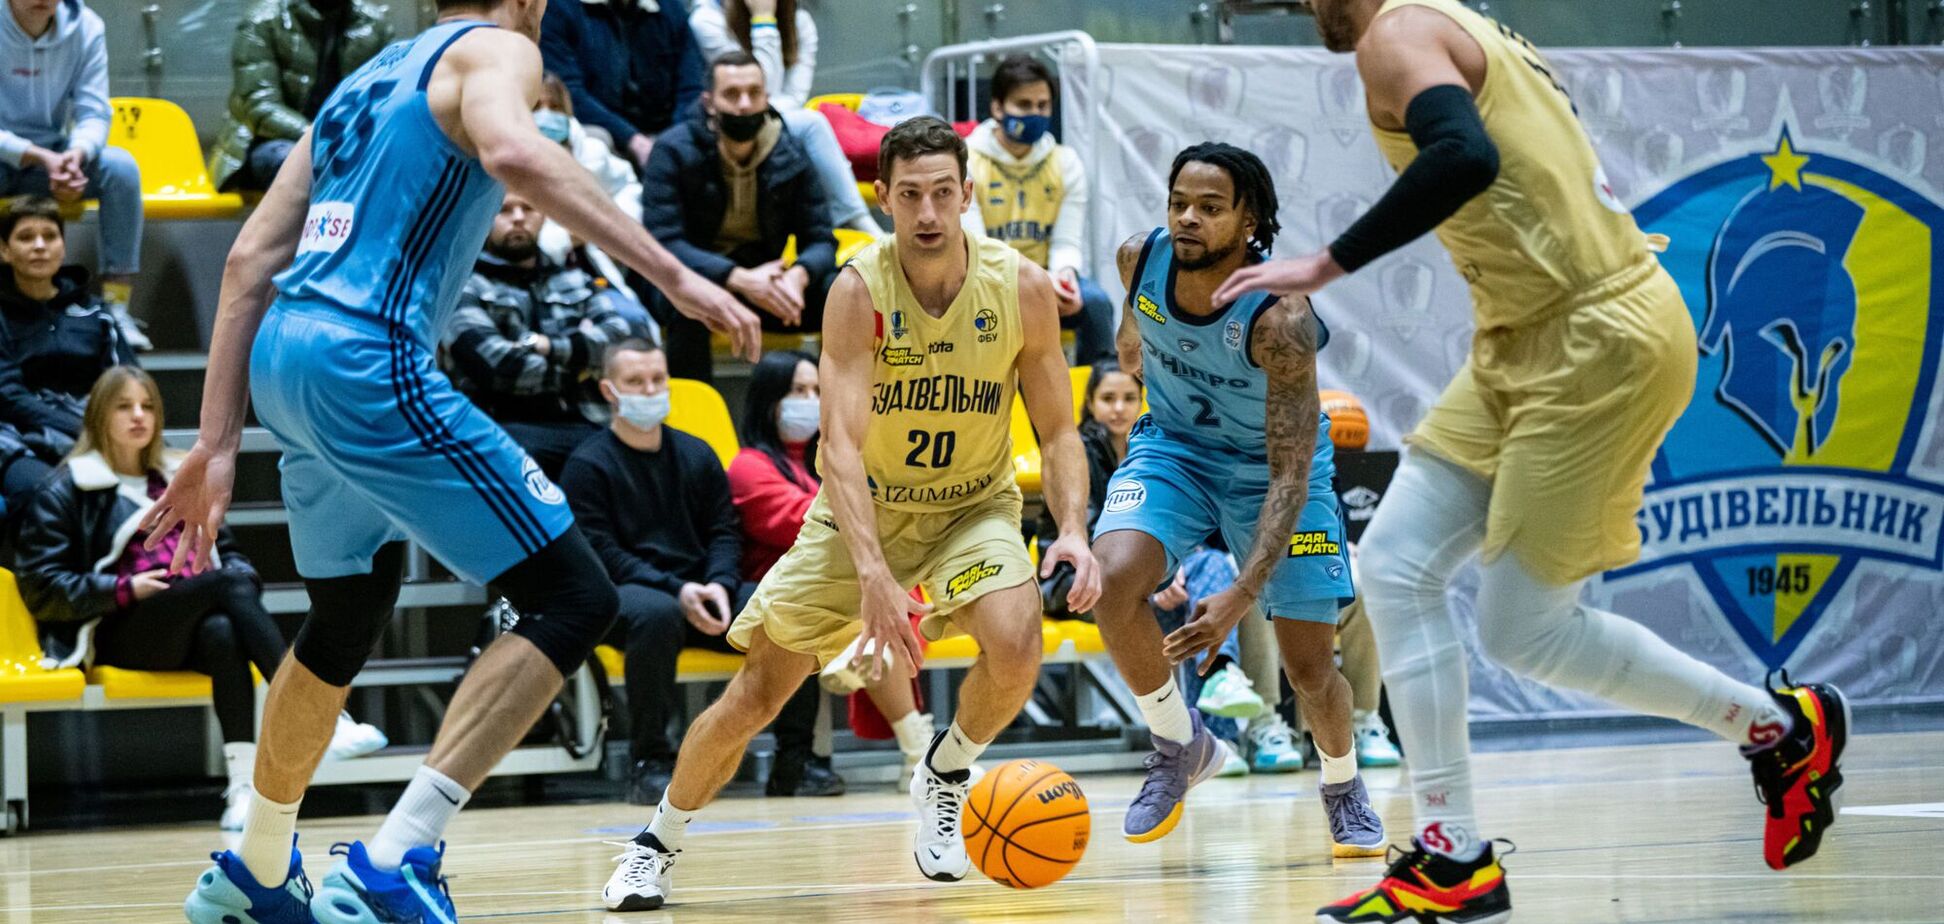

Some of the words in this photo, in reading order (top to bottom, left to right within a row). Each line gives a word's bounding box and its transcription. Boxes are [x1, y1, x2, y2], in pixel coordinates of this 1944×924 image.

[977, 333, 998, 344] ФБУ
[1188, 394, 1221, 428] 2
[905, 429, 956, 469] 20
[1291, 533, 1326, 545] PARI
[1291, 543, 1339, 556] MATCH
[1746, 564, 1811, 596] 1945
[1038, 780, 1085, 805] lson
